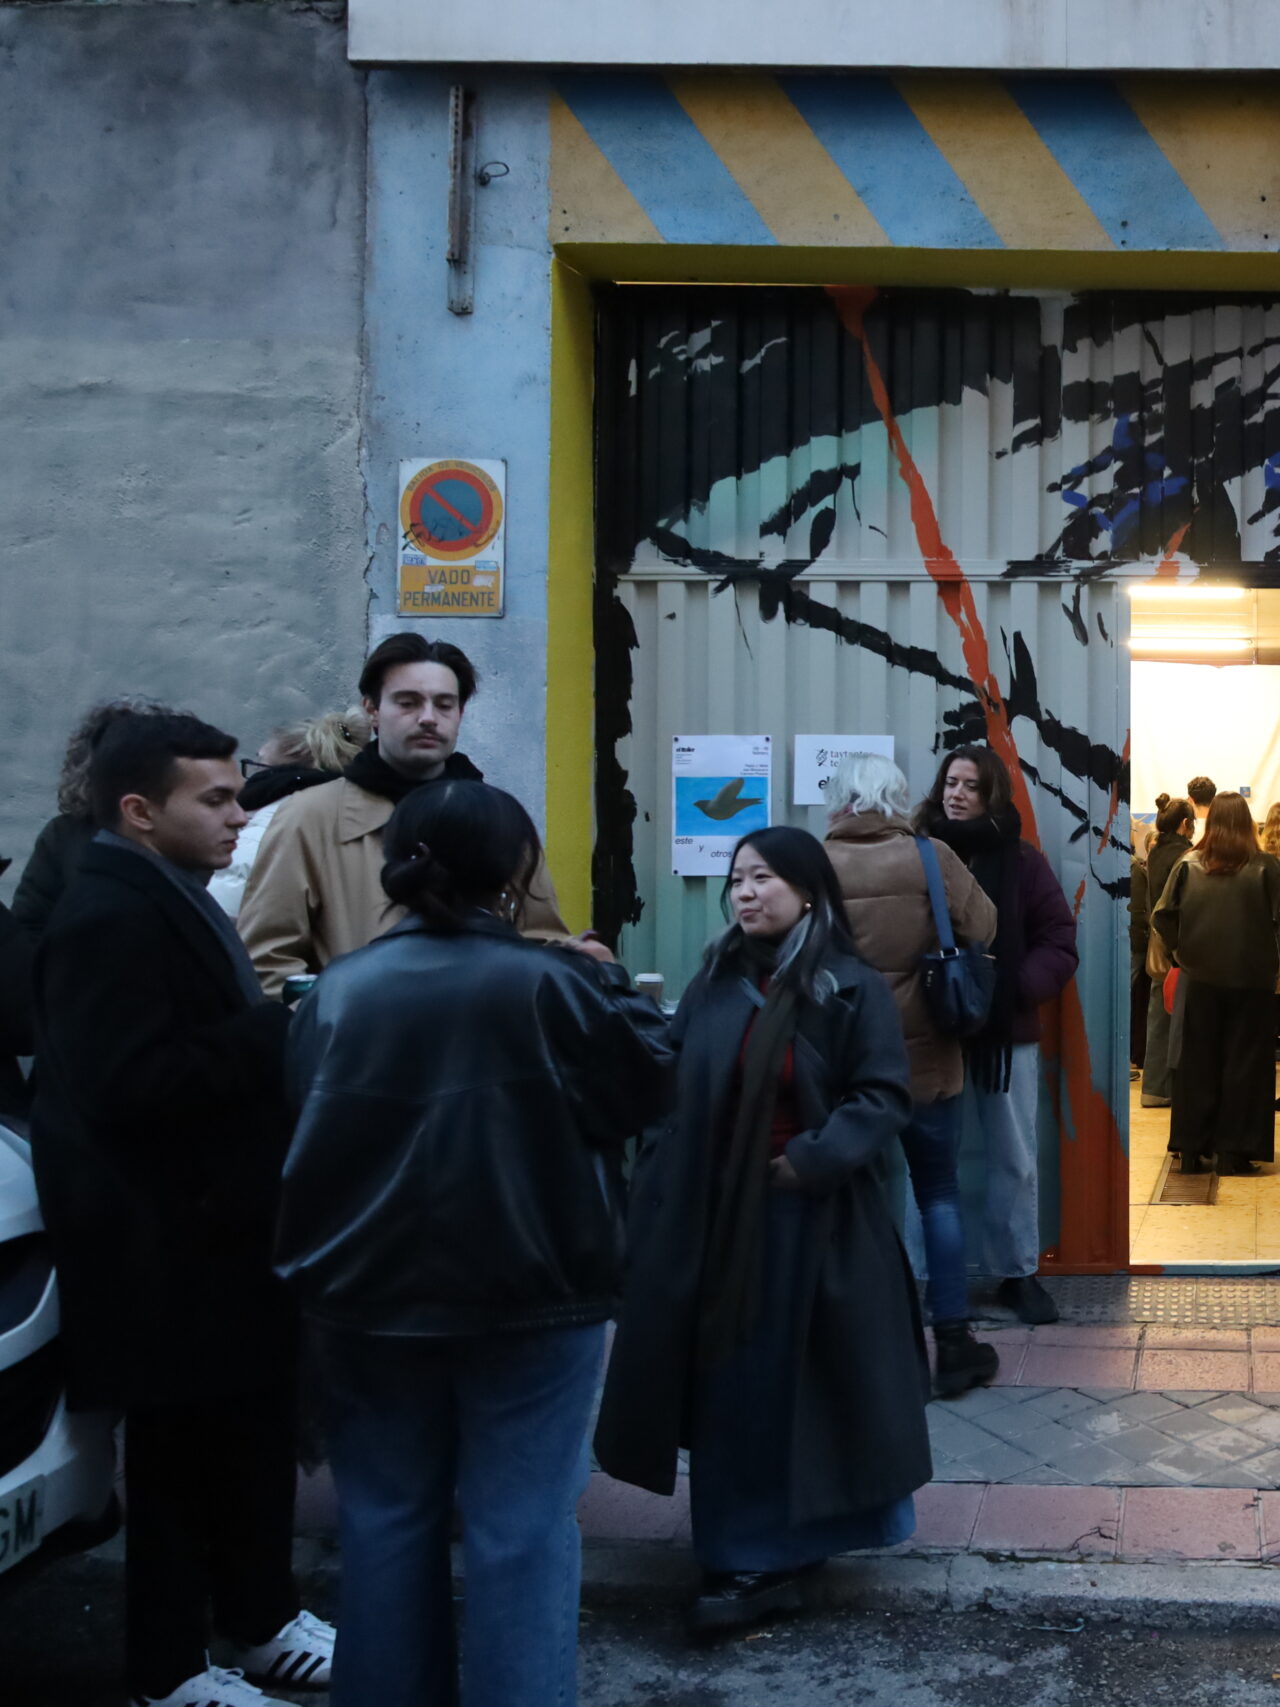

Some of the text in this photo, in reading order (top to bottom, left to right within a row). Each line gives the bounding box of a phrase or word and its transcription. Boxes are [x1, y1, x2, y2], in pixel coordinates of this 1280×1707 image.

[427, 569, 471, 585] VADO
[403, 591, 496, 607] PERMANENTE
[698, 844, 704, 853] y
